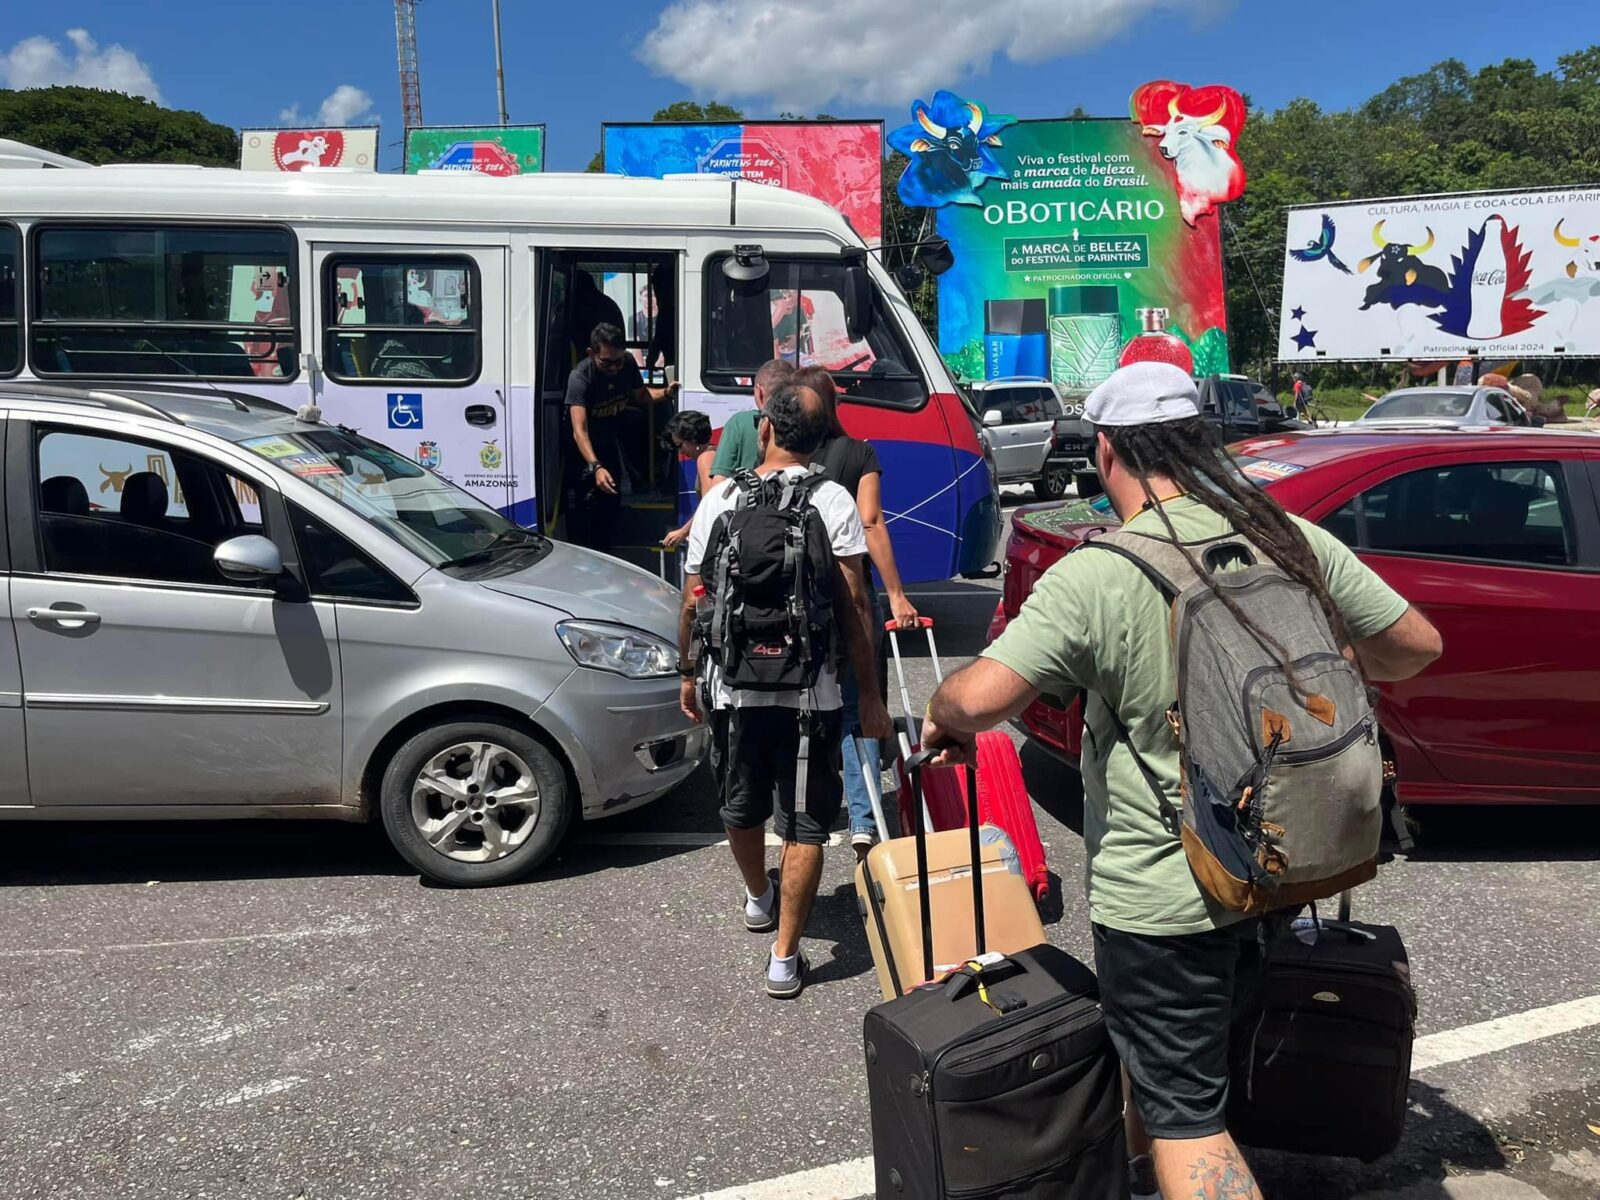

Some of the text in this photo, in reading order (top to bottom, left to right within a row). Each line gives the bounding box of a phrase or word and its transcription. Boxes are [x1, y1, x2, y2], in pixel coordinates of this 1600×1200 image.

[1017, 153, 1130, 166] Viva o festival com
[746, 170, 764, 178] TEM
[1013, 163, 1136, 178] a marca de beleza
[1000, 174, 1149, 190] mais amada do Brasil.
[1368, 204, 1420, 216] CULTURA,
[1424, 202, 1460, 212] MAGIA
[1464, 200, 1471, 209] E
[1473, 196, 1544, 208] COCA-COLA
[1547, 194, 1565, 204] EM
[1011, 241, 1141, 255] A MARCA DE BELEZA
[1011, 252, 1141, 265] DO FESTIVAL DE PARINTINS
[1032, 271, 1122, 282] PATROCINADOR OFICIAL
[1489, 343, 1518, 351] Oficial
[1521, 343, 1544, 351] 2024
[464, 480, 519, 488] AMAZONAS
